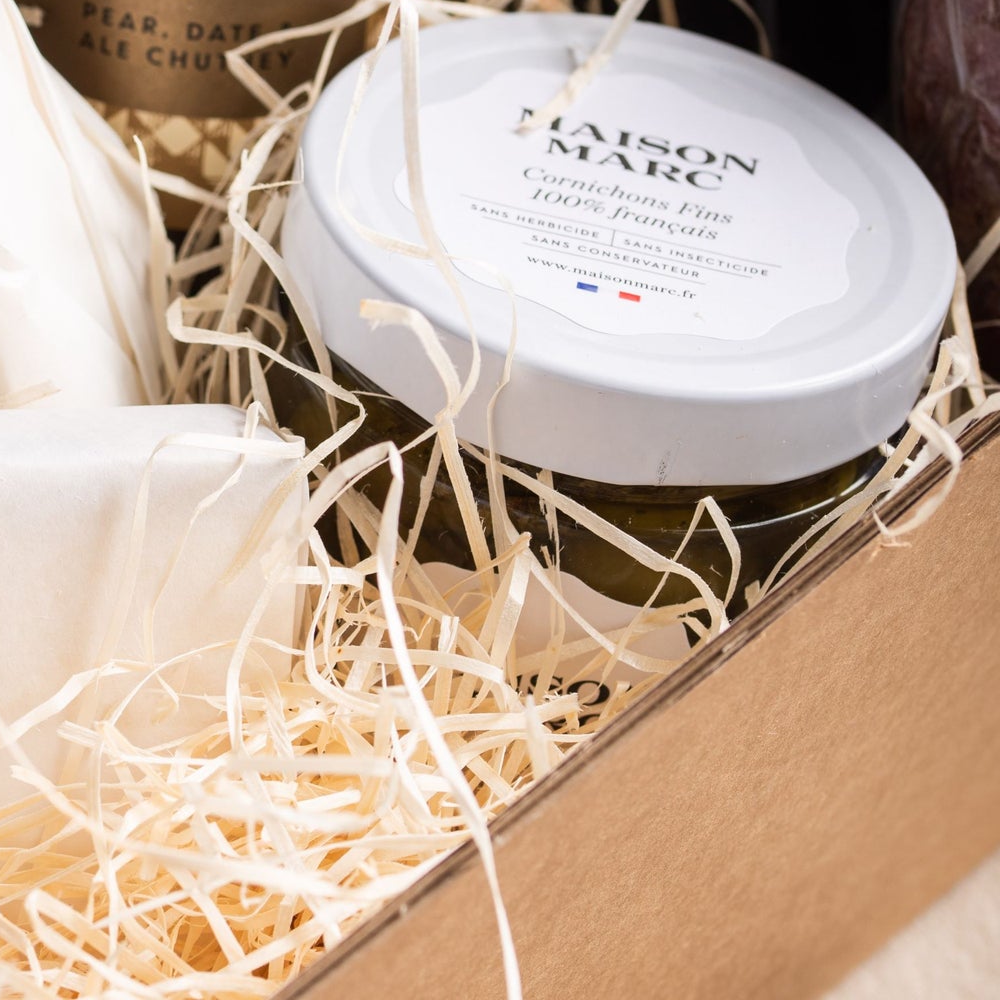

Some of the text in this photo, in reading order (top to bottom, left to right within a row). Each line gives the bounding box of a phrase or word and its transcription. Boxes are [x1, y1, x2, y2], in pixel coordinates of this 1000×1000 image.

[78, 30, 297, 72] ALE CHUTEY
[546, 137, 725, 191] MARC
[522, 165, 735, 226] Cornichons Fins
[531, 187, 720, 242] 100% français
[470, 203, 601, 239] SANS HERBICIDE
[525, 254, 697, 301] www.maisonmarc.fr
[530, 234, 702, 280] SANS CONSERVATEUR
[623, 238, 770, 278] SANS INSECTICIDE
